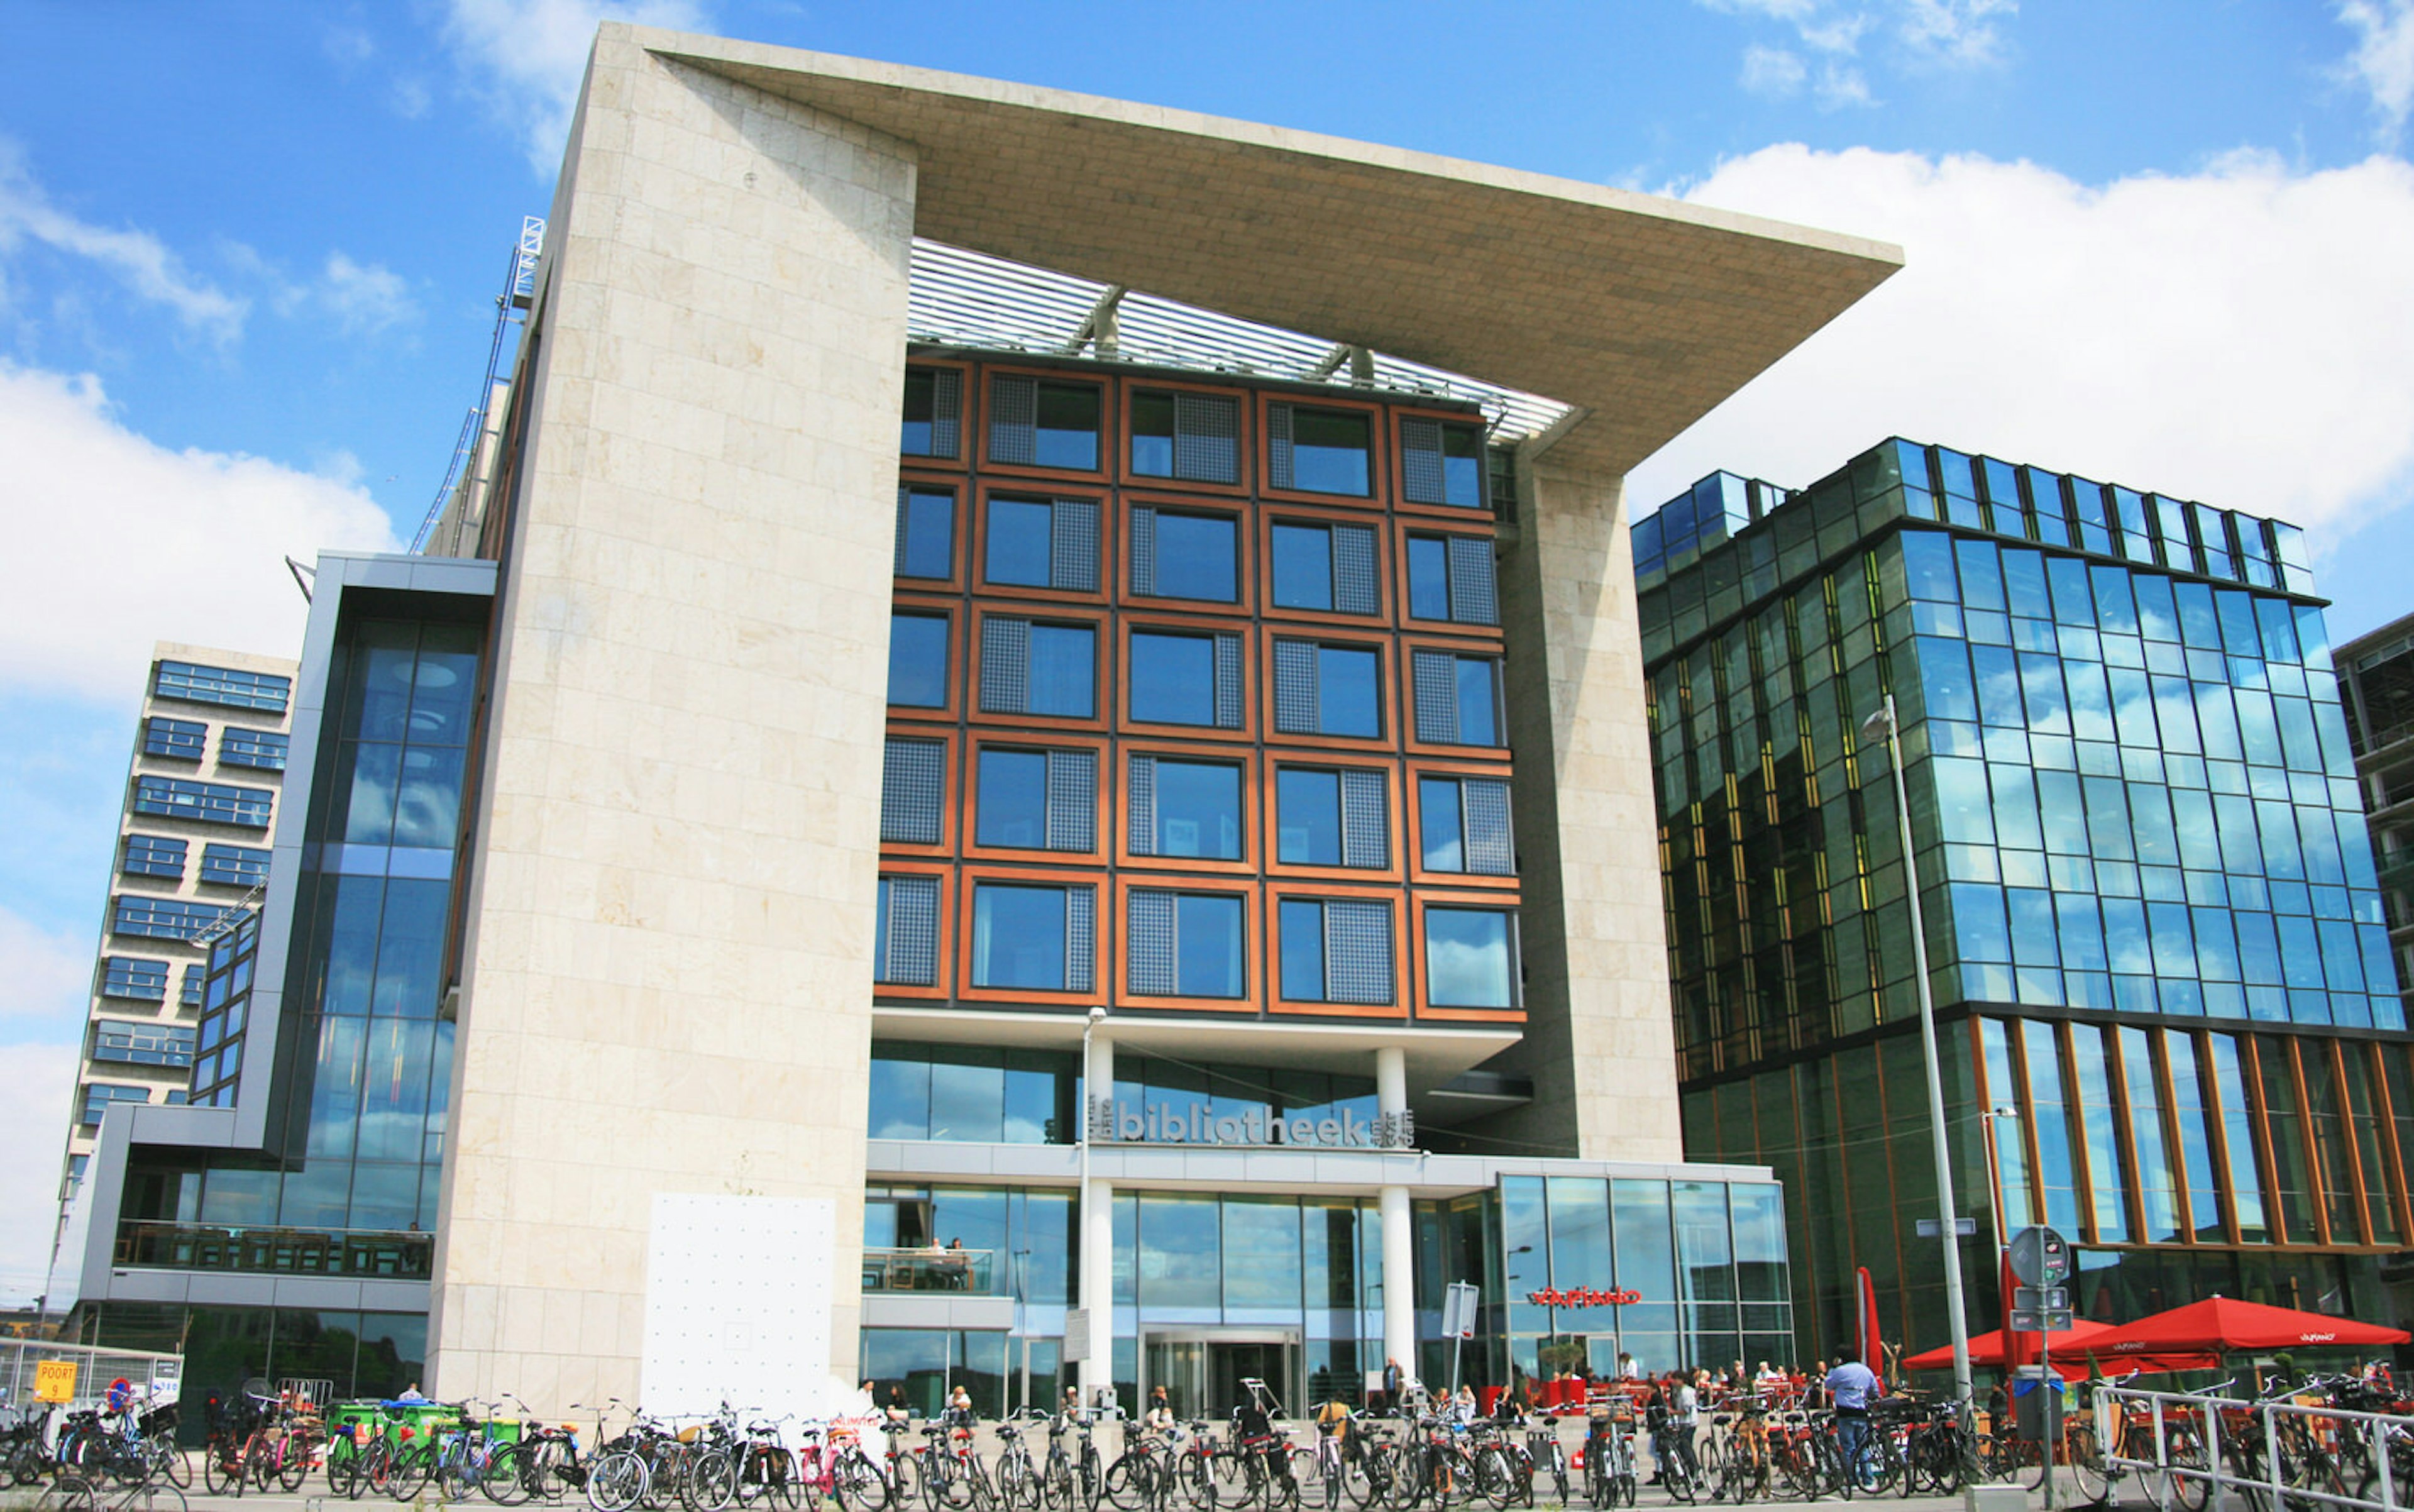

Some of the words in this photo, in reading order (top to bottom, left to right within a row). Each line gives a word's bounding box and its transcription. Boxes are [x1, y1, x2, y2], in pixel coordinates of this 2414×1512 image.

[1117, 1101, 1367, 1145] bibliotheek
[41, 1367, 73, 1381] POORT
[52, 1384, 58, 1396] 9
